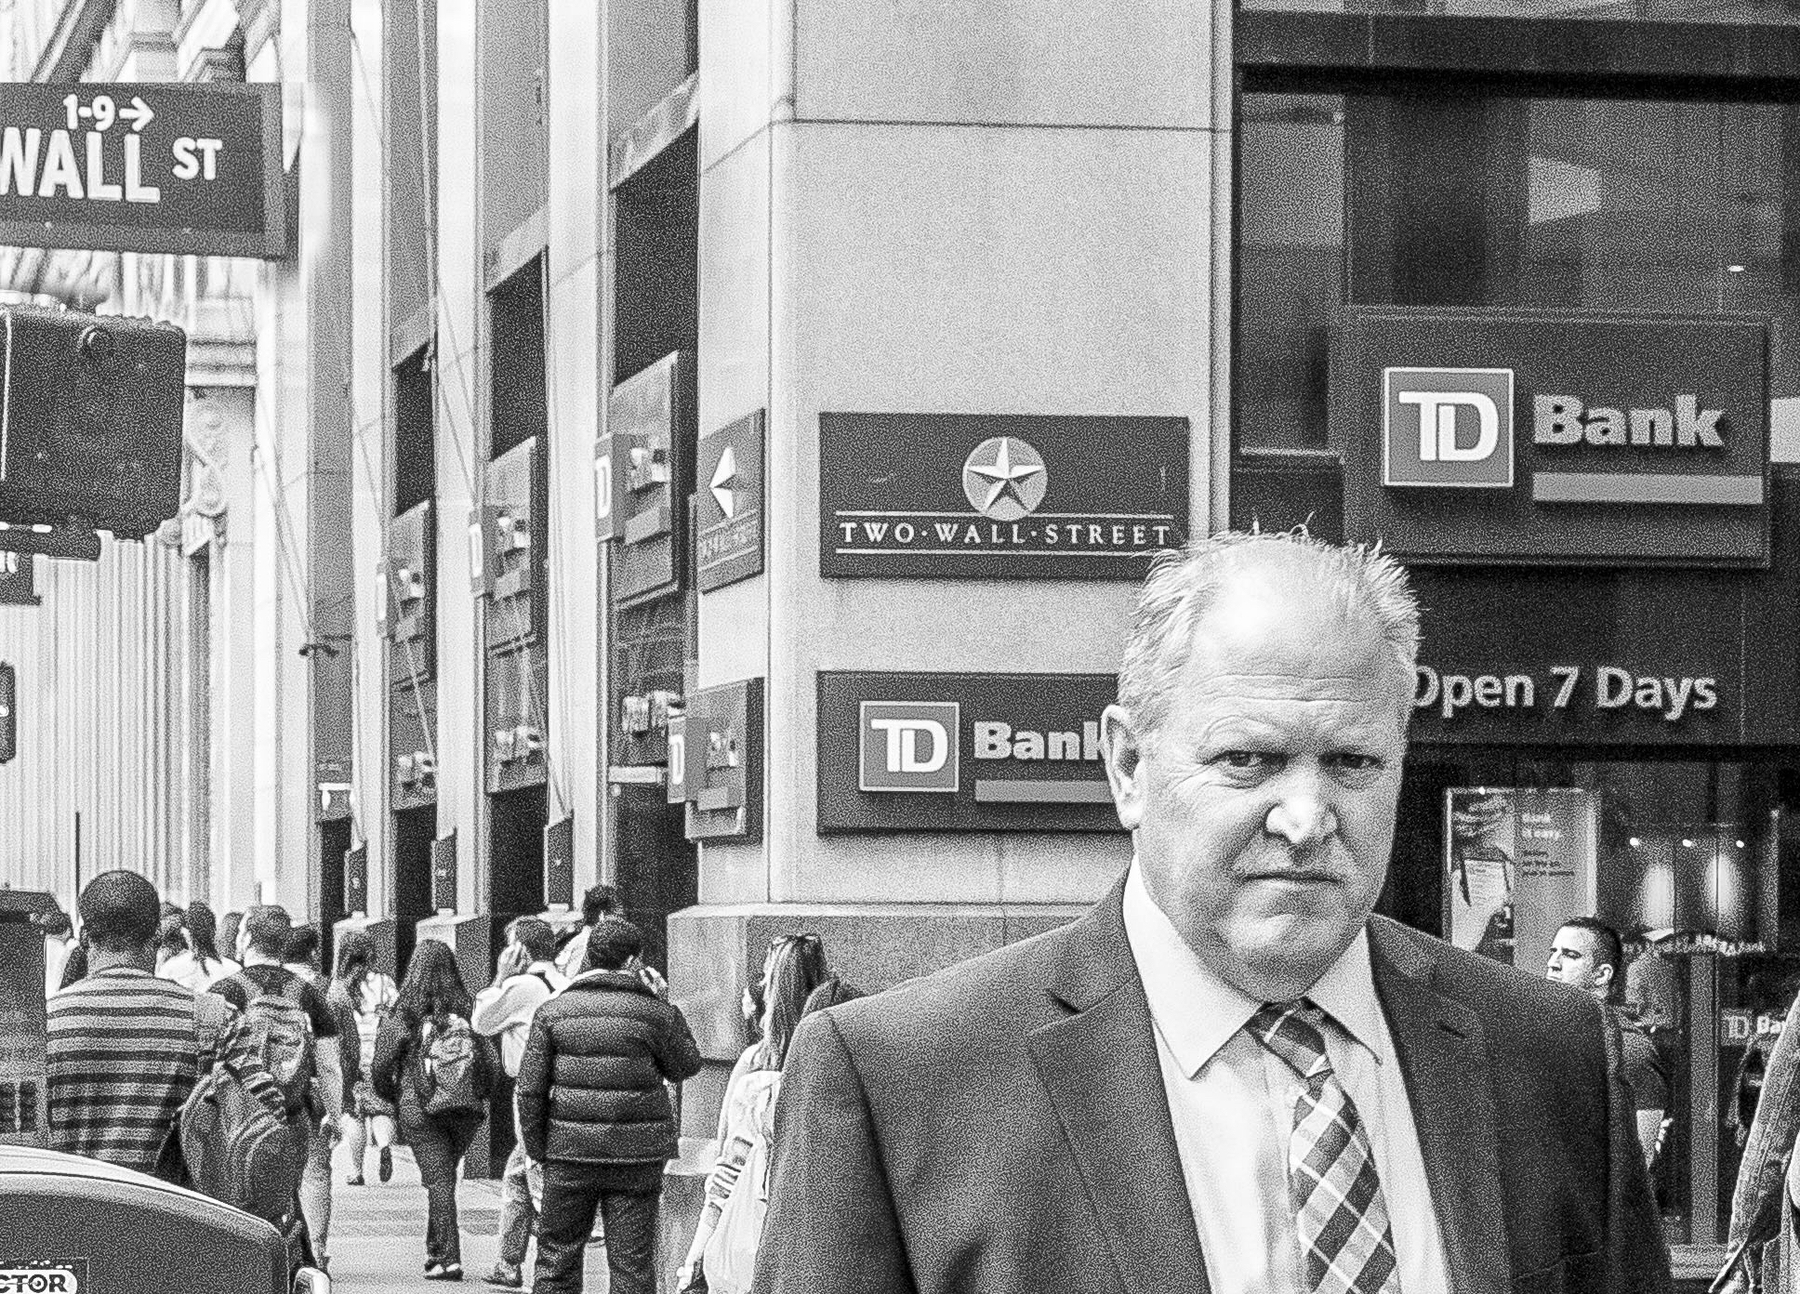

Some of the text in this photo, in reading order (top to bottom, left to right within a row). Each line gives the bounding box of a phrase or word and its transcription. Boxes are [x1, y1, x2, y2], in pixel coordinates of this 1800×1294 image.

[63, 94, 115, 131] 1-9
[0, 126, 223, 203] WALL ST
[1398, 391, 1725, 462] TD Bank
[839, 522, 1170, 546] TWO WALL STREET
[1551, 666, 1579, 707] 7
[1598, 666, 1717, 721] Days
[870, 719, 948, 772] TD
